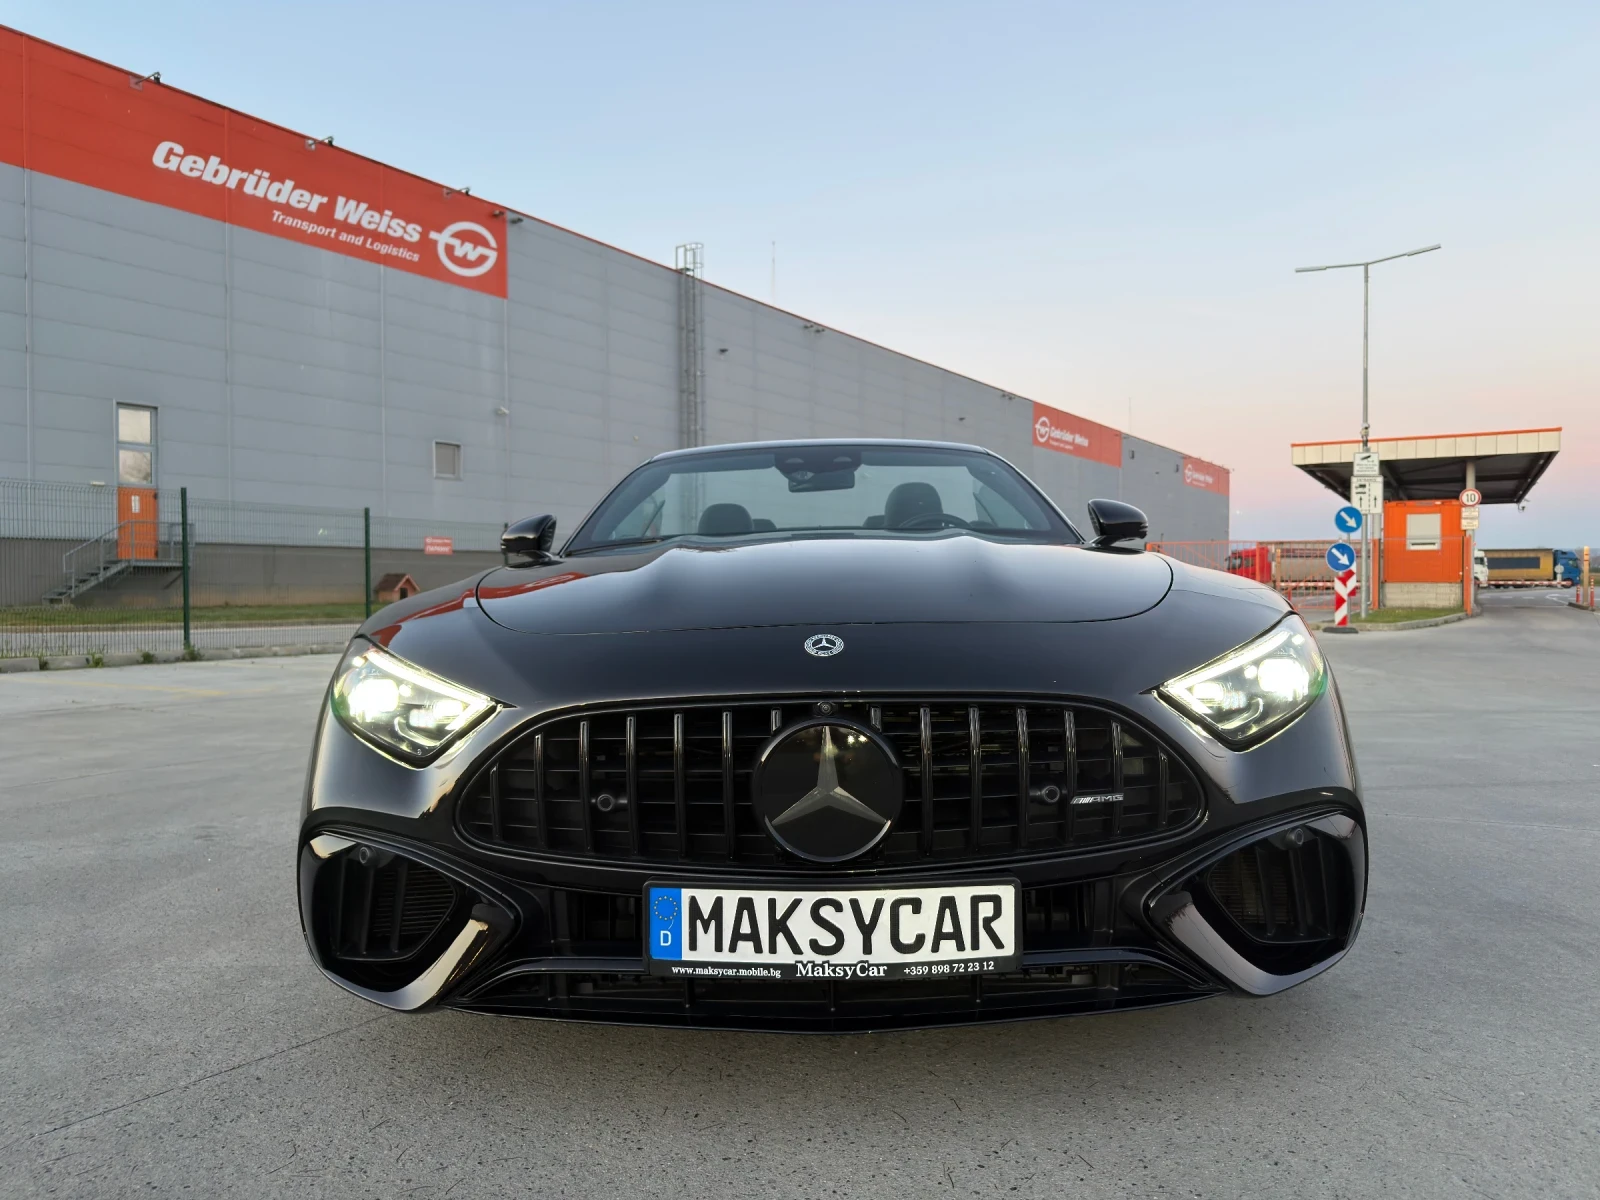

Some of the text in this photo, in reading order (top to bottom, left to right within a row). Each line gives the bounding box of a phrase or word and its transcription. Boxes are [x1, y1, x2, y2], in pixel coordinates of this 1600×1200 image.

[152, 140, 423, 243] Gebrüder Weiss
[272, 209, 421, 263] Transport and Logistics
[1465, 493, 1476, 503] 10
[687, 893, 1006, 956] MAKSYCAR
[659, 930, 672, 946] D
[671, 966, 782, 979] www.maksycar.mobile.bg
[795, 961, 888, 979] MaksyCar
[903, 961, 995, 976] +359 898 72 23 12
